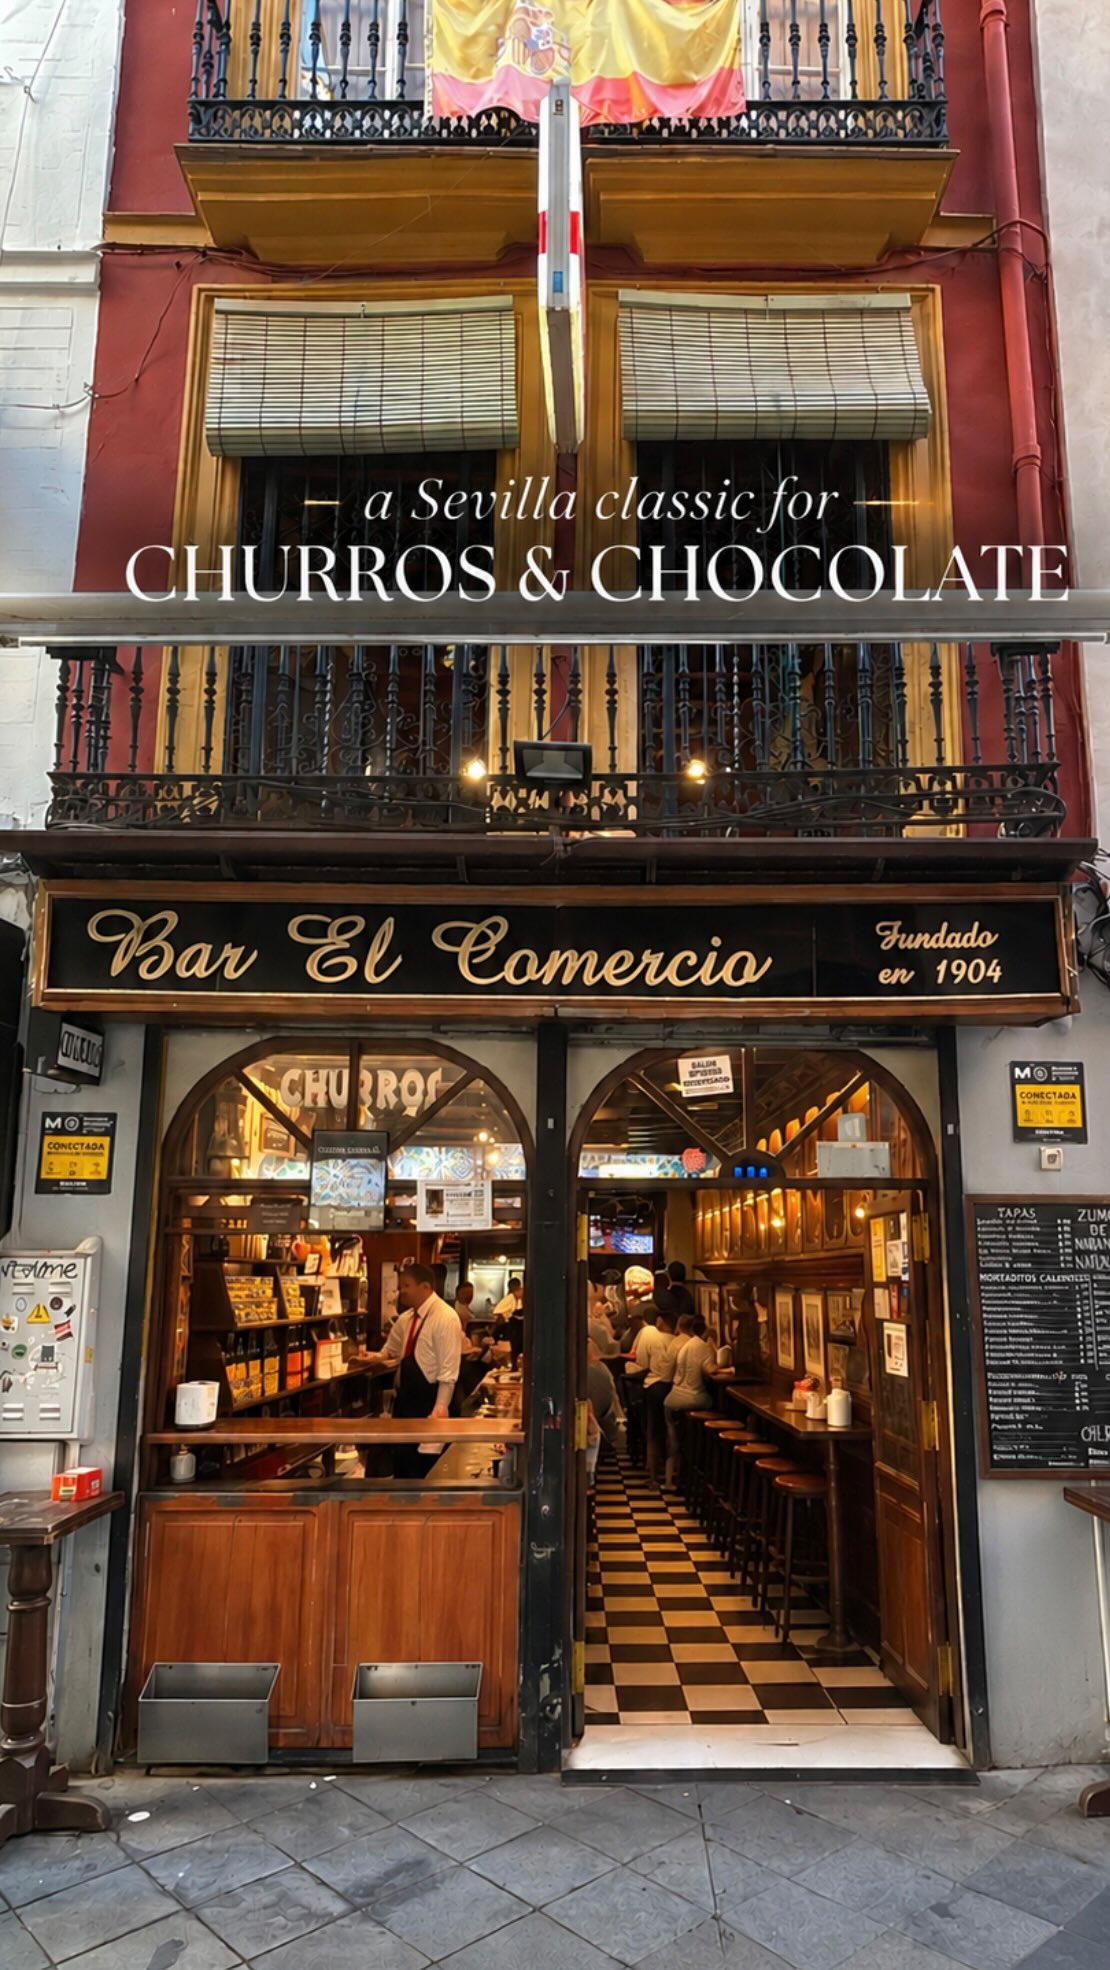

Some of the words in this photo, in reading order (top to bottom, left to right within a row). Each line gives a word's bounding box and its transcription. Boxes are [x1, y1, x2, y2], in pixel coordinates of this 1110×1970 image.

[875, 920, 999, 950] Fundado
[87, 909, 258, 980] Bar
[287, 914, 402, 984] El
[431, 915, 773, 987] Comercio
[878, 968, 915, 984] en
[936, 958, 1002, 984] 1904
[280, 1068, 442, 1110] CHURROS
[1020, 1092, 1077, 1100] CONECTADA
[47, 1142, 104, 1151] CONECTADA
[997, 1207, 1036, 1219] TAPAS
[1089, 1224, 1107, 1236] DE
